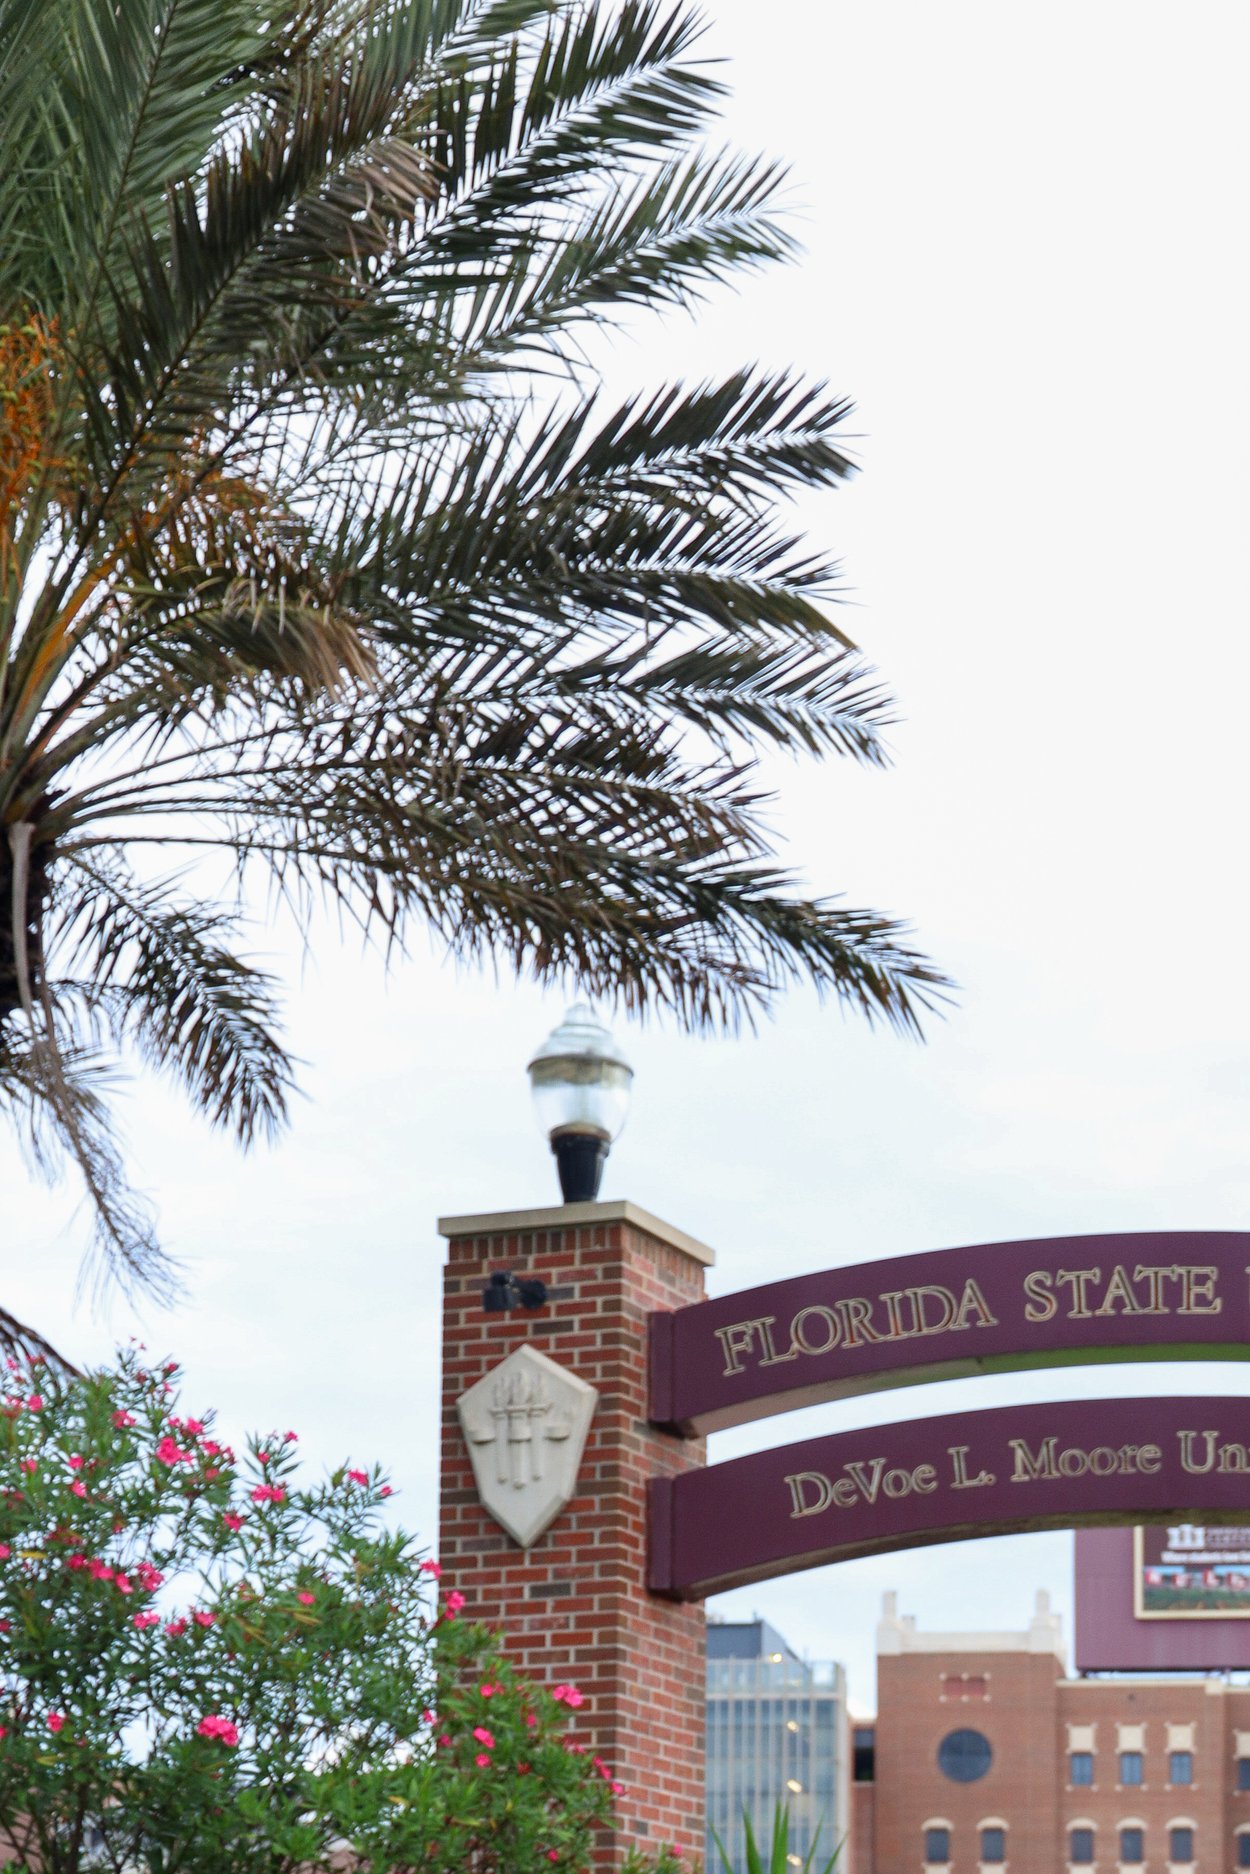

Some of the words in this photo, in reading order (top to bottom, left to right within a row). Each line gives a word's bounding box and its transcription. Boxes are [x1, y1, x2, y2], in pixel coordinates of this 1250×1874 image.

[715, 1278, 998, 1376] FLORIDA
[1024, 1264, 1222, 1321] STATE
[784, 1457, 938, 1518] DeVoe
[948, 1446, 995, 1489] L.
[1008, 1436, 1162, 1482] Moore
